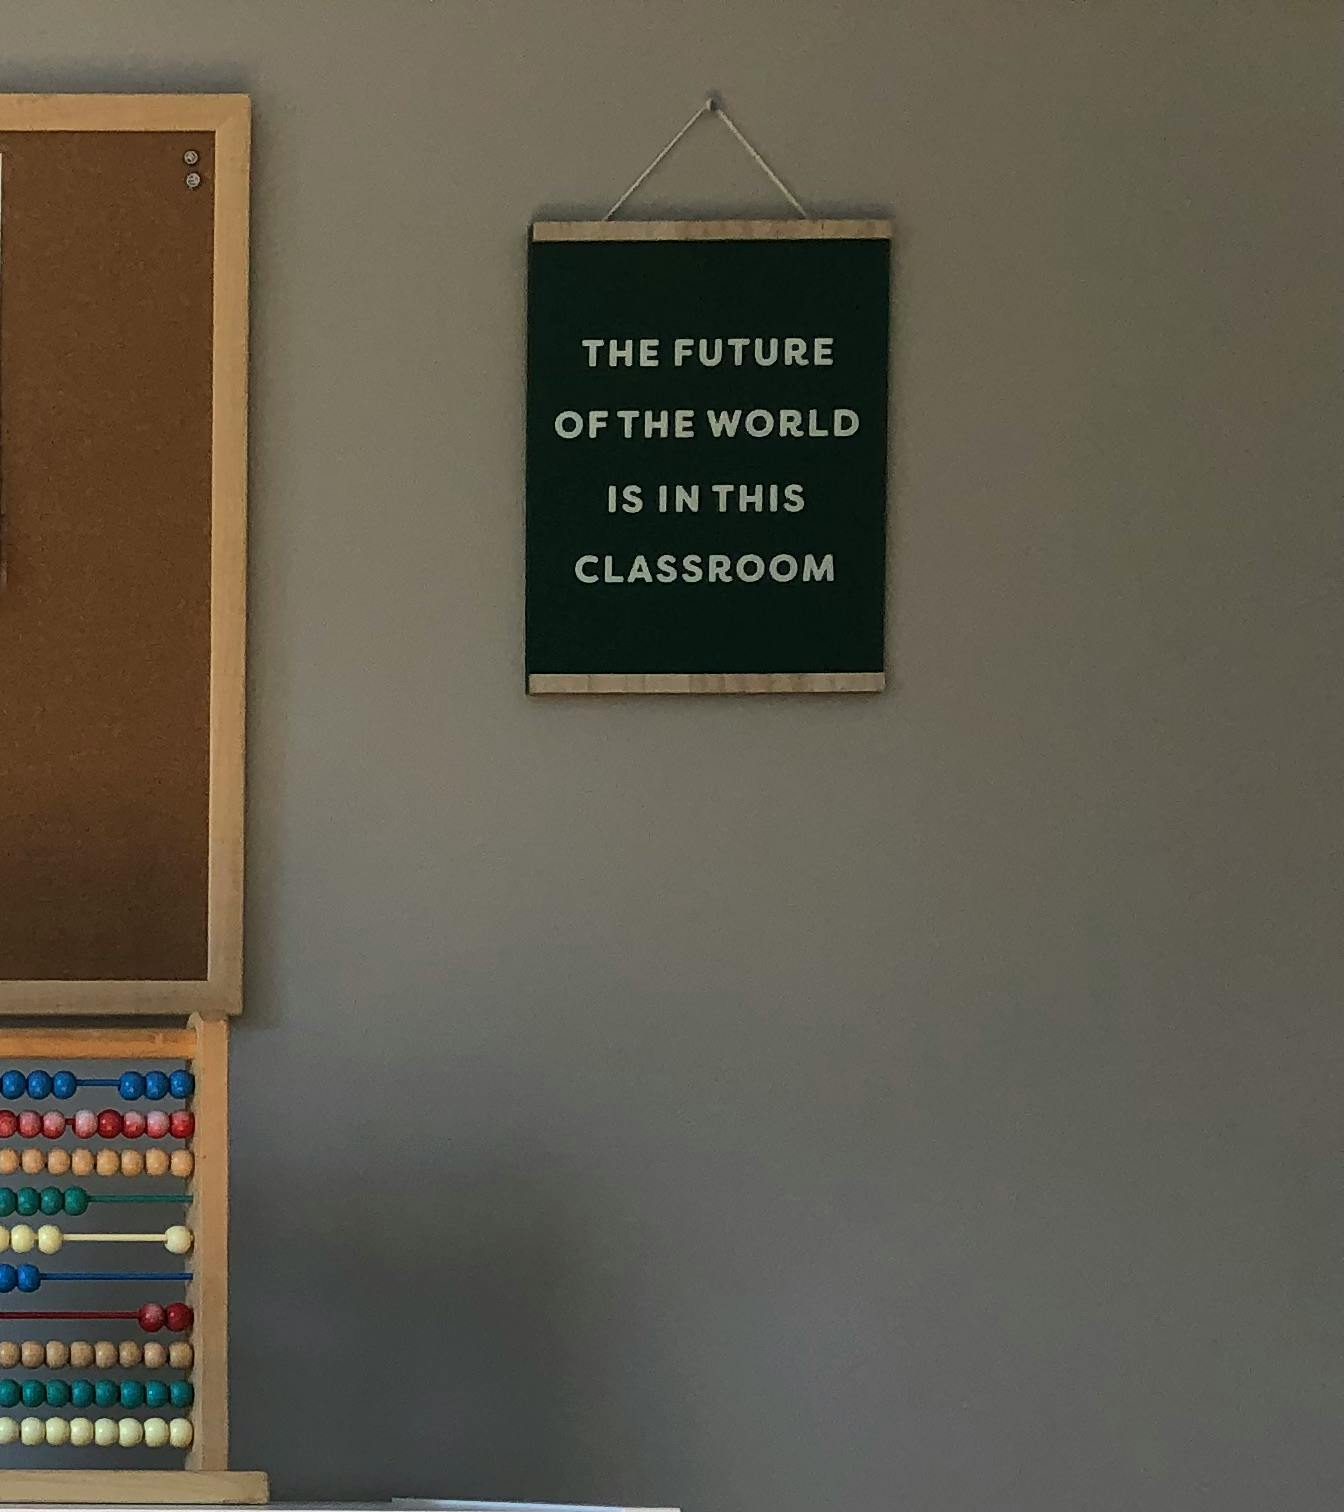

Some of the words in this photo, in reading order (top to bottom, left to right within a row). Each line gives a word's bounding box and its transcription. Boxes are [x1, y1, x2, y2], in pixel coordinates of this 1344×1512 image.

[581, 338, 660, 367] THE
[674, 337, 834, 367] FUTURE
[554, 410, 609, 439] OF
[616, 410, 695, 439] THE
[706, 408, 860, 438] WORLD
[608, 484, 644, 513] IS
[658, 484, 700, 513] IN
[711, 484, 805, 513] THIS
[574, 553, 835, 584] CLASSROOM
